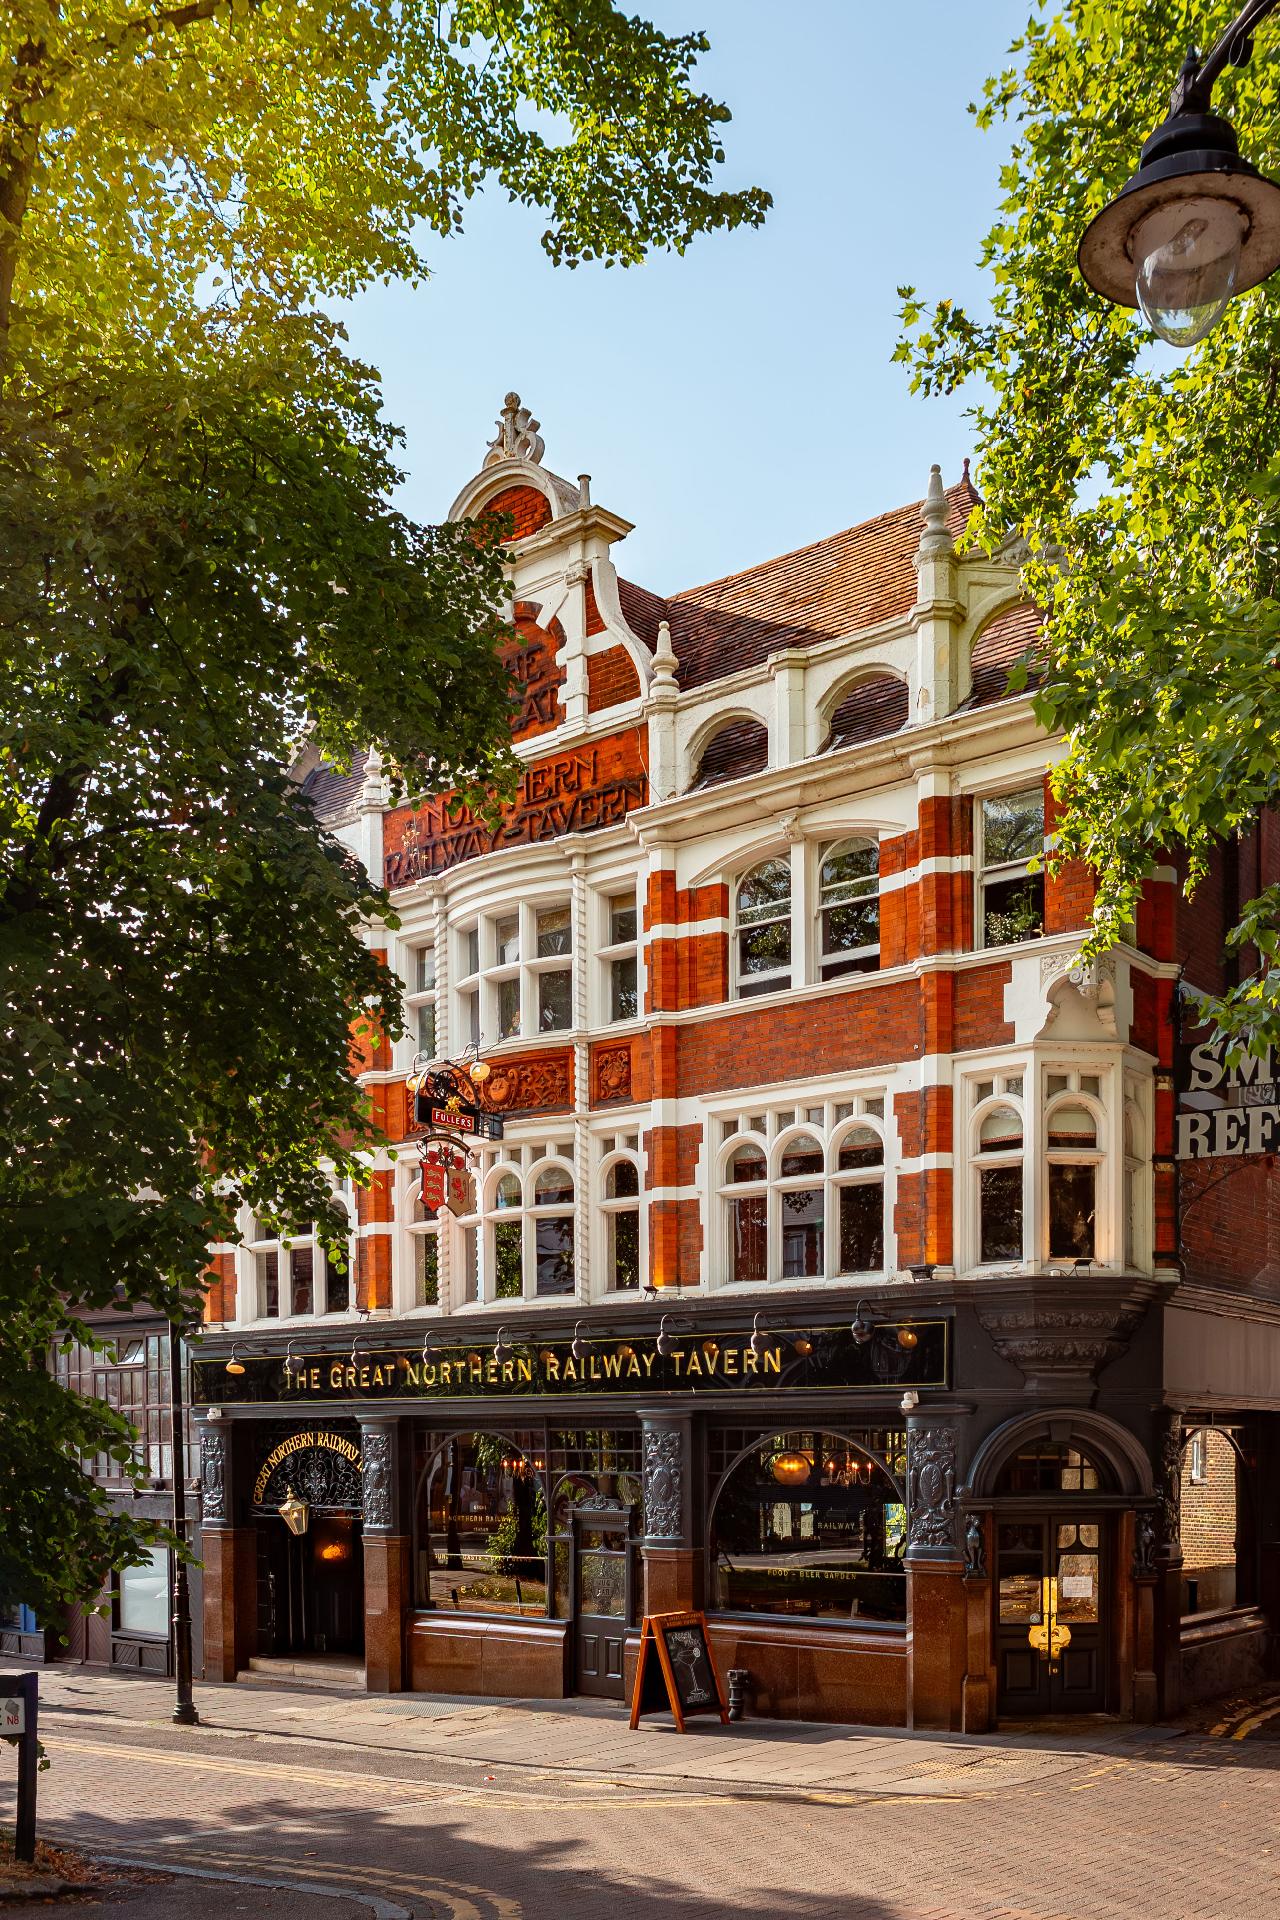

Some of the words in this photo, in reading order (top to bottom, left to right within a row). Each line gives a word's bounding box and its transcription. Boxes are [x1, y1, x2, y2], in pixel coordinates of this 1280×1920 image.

[425, 750, 597, 836] NOERN
[1188, 1041, 1280, 1091] SM
[1175, 1104, 1280, 1160] REF
[285, 1368, 320, 1389] THE
[330, 1364, 395, 1388] GREAT
[406, 1358, 532, 1386] NORTHERN
[547, 1353, 656, 1381] RAILWAY
[671, 1348, 781, 1376] TAVERN
[253, 1463, 272, 1505] GREAT
[269, 1432, 314, 1470] NORTHERN
[317, 1432, 359, 1461] RAILWAY
[817, 1522, 855, 1530] RAILWAY
[767, 1569, 788, 1577] FOOD
[824, 1572, 857, 1580] GARDEN
[6, 1715, 19, 1726] N8
